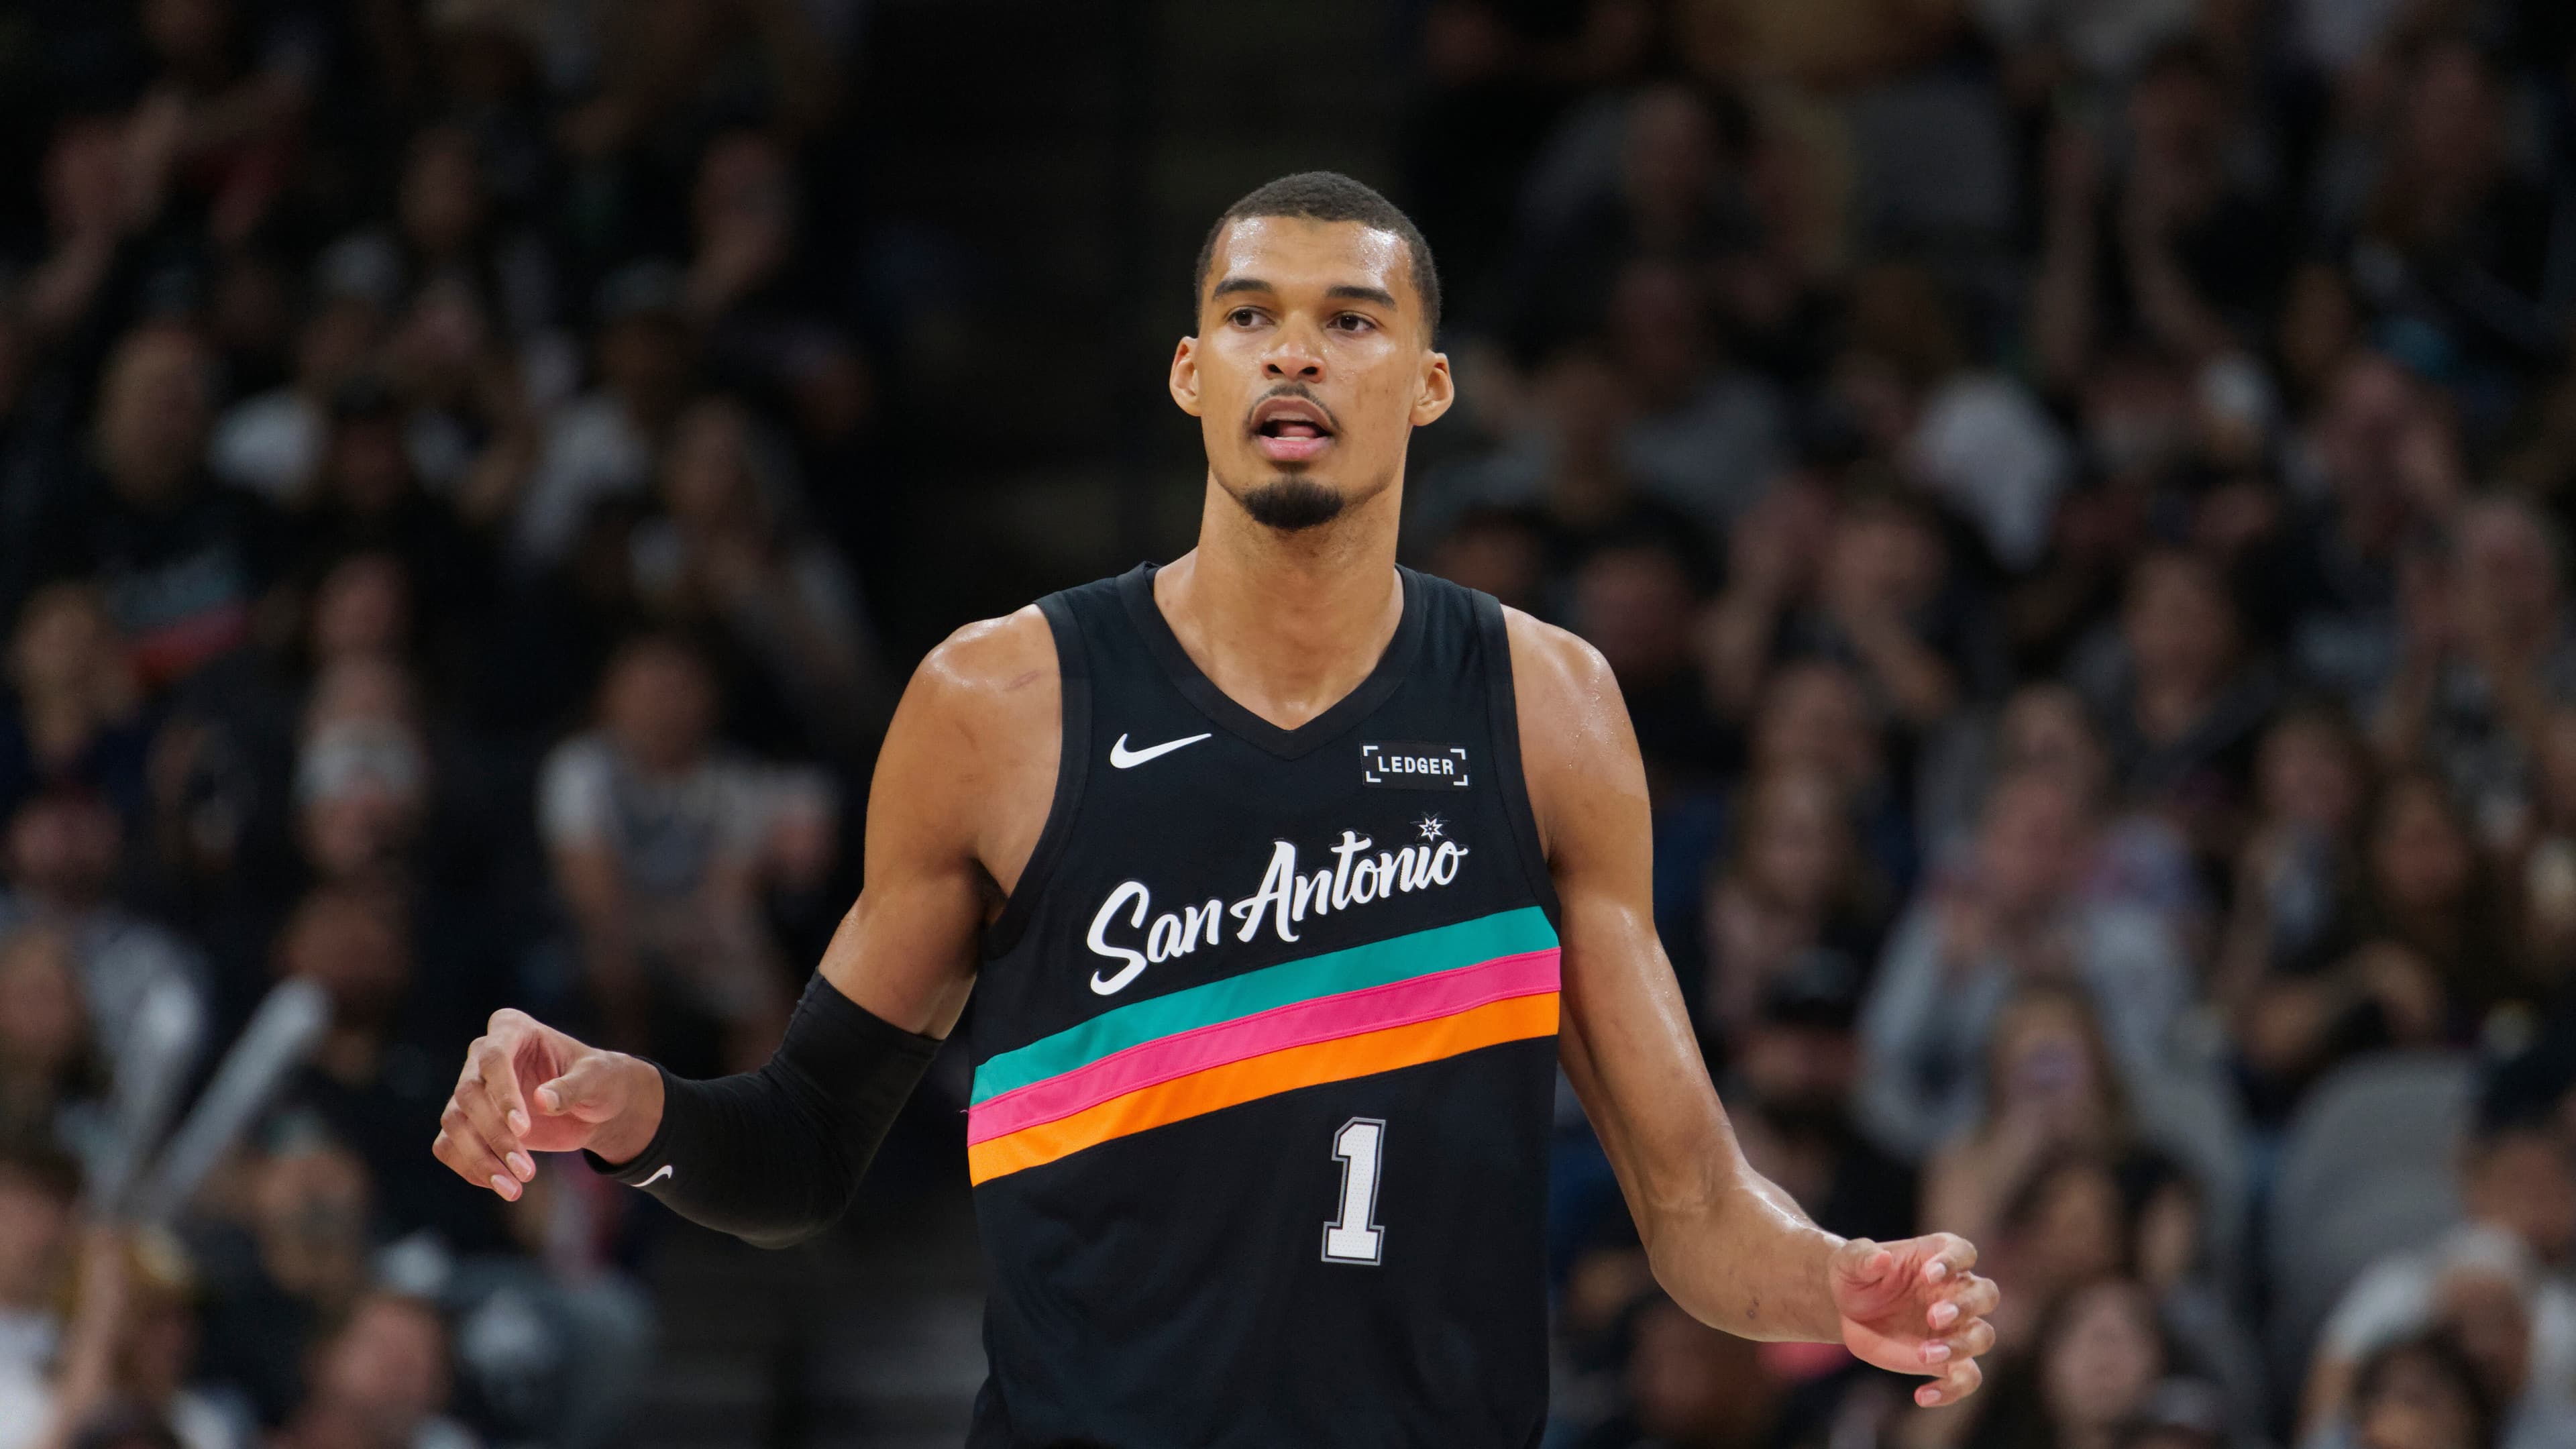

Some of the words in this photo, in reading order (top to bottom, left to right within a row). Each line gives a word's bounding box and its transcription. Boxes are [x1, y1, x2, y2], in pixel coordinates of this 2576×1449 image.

[1377, 756, 1454, 775] LEDGER
[1087, 881, 1222, 996] San
[1230, 817, 1468, 942] Antonio
[1321, 1116, 1386, 1266] 1
